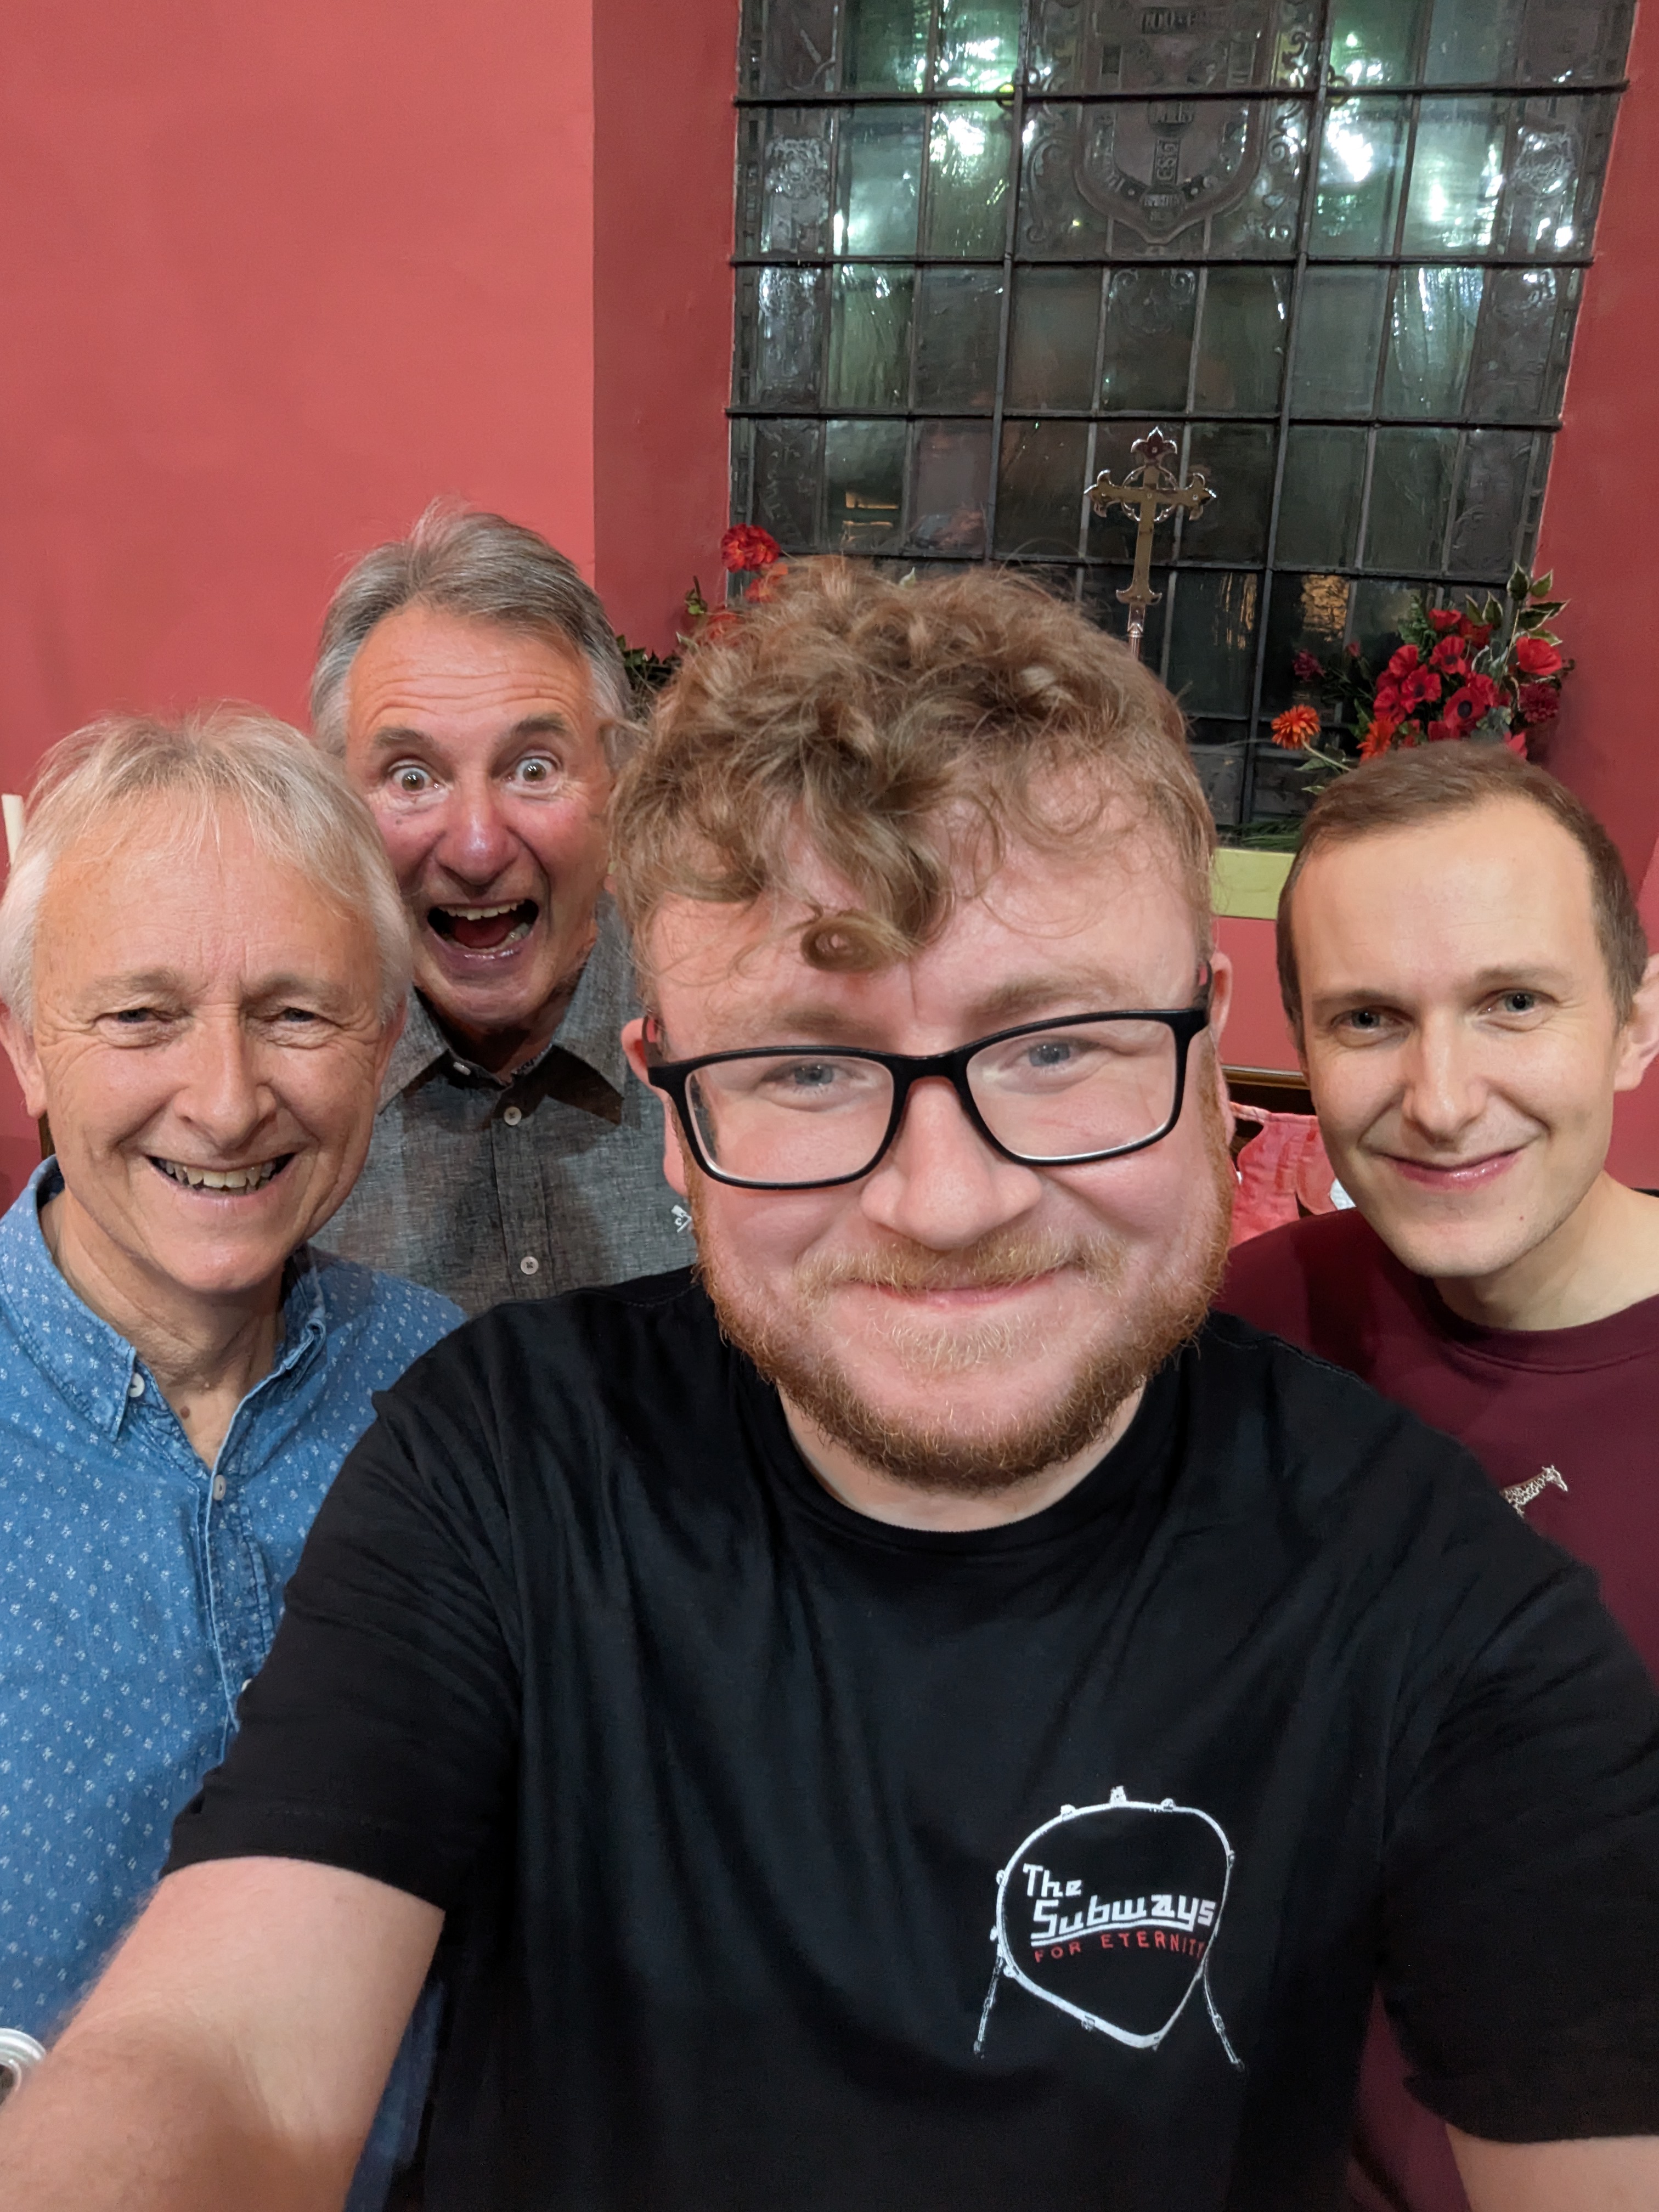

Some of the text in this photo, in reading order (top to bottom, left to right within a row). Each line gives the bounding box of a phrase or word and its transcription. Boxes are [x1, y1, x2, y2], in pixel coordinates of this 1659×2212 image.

[1023, 1863, 1082, 1898] The
[1031, 1894, 1217, 1941] Subways
[1034, 1941, 1081, 1963] FOR
